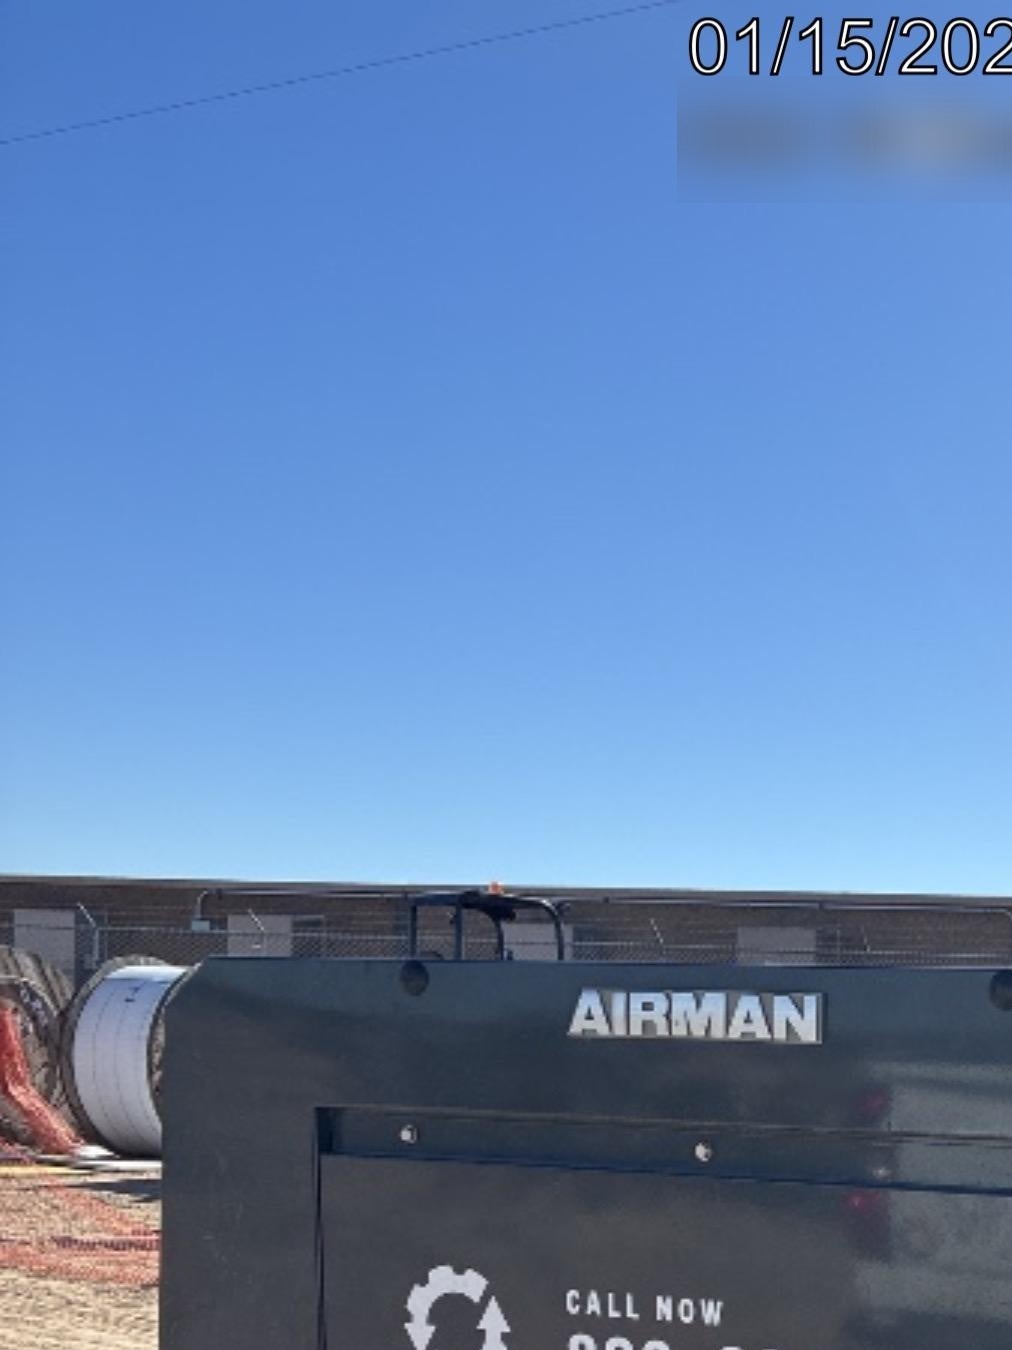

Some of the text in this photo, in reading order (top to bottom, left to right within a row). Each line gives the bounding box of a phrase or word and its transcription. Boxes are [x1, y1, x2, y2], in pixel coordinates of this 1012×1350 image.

[566, 987, 822, 1045] AIRMAN
[565, 1288, 724, 1327] CALL NOW
